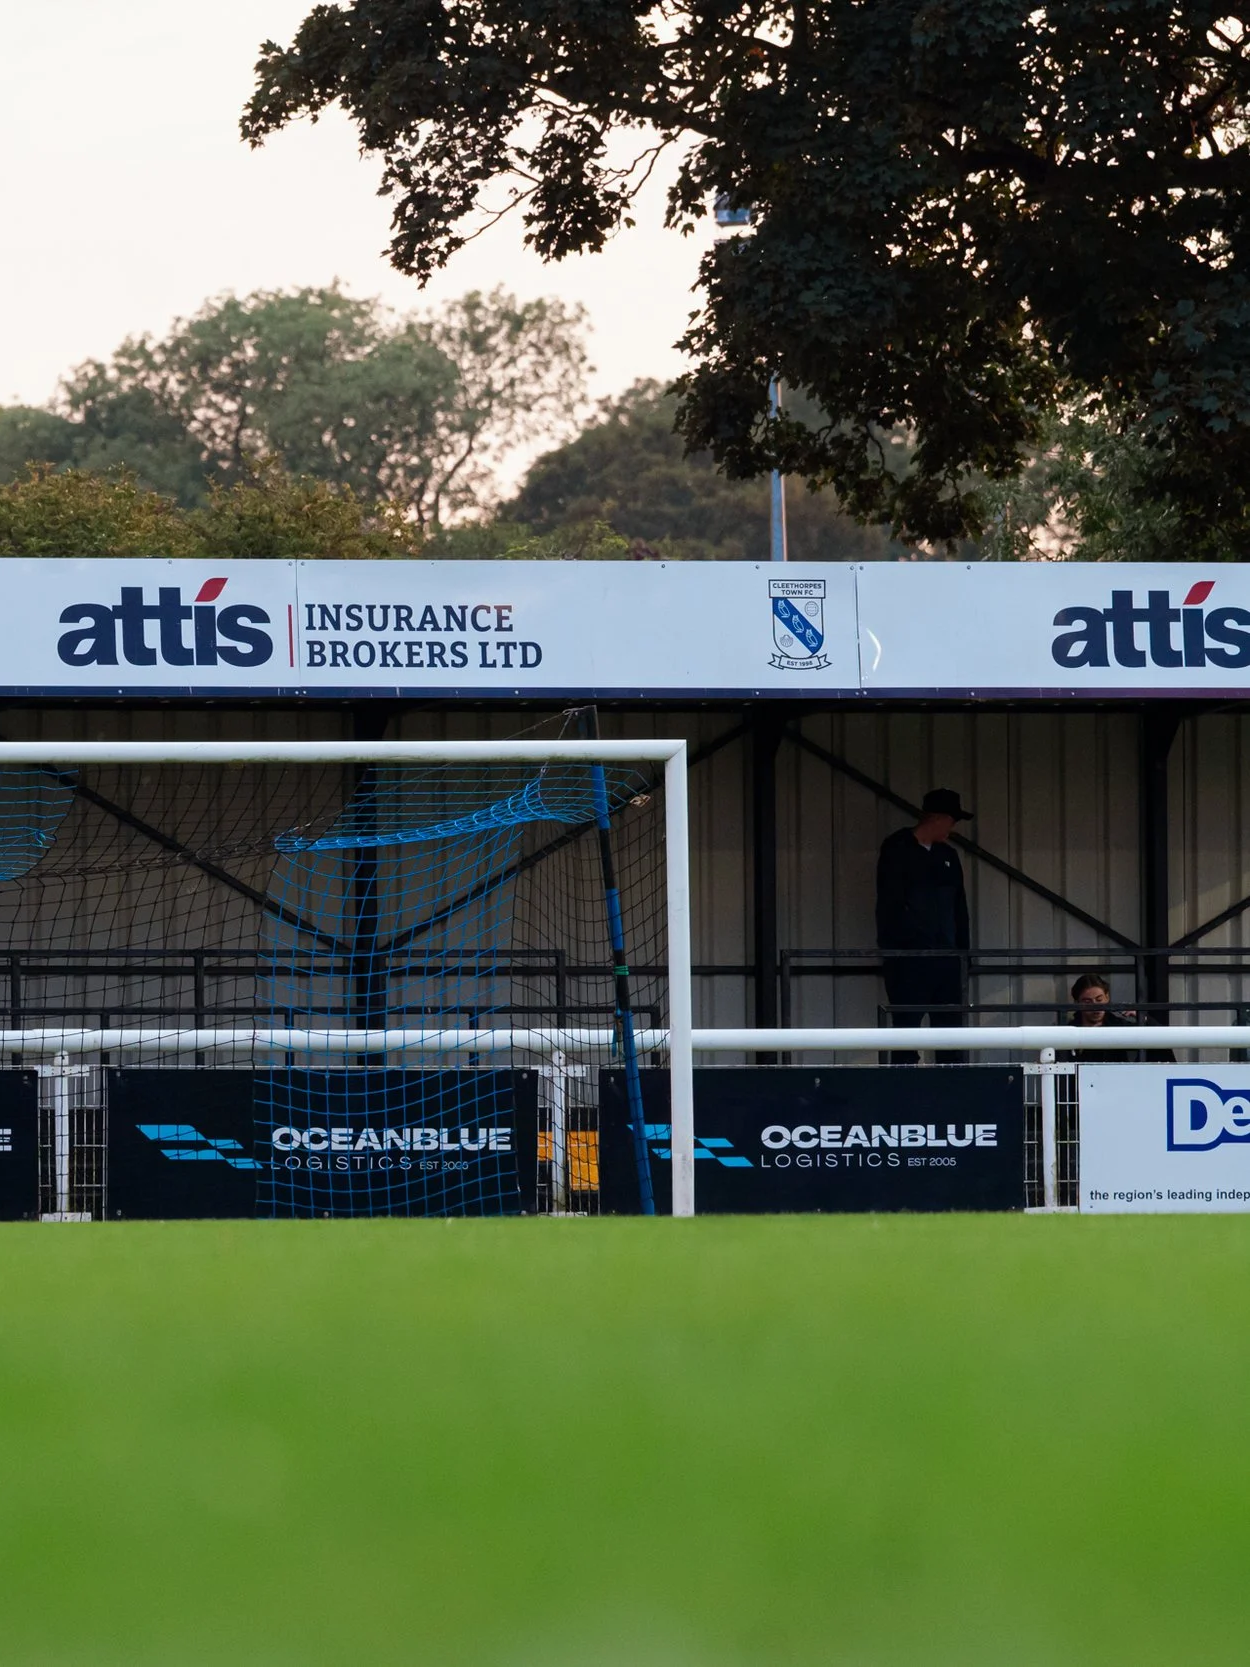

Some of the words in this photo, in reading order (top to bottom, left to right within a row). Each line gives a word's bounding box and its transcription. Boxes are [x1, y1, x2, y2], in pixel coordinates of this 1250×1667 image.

[57, 577, 274, 668] attis
[305, 603, 514, 633] INSURANCE
[1051, 580, 1250, 669] attis
[306, 640, 469, 669] BROKERS
[478, 641, 543, 669] LTD
[272, 1127, 512, 1151] OCEANBLUE
[761, 1124, 998, 1149] OCEANBLUE
[270, 1156, 412, 1170] LOGISTICS
[419, 1161, 439, 1170] EST
[761, 1153, 900, 1168] LOGISTICS
[907, 1157, 927, 1167] EST
[929, 1157, 957, 1167] 2005
[1090, 1189, 1110, 1201] the
[1113, 1189, 1163, 1203] region's
[1167, 1189, 1212, 1203] leading
